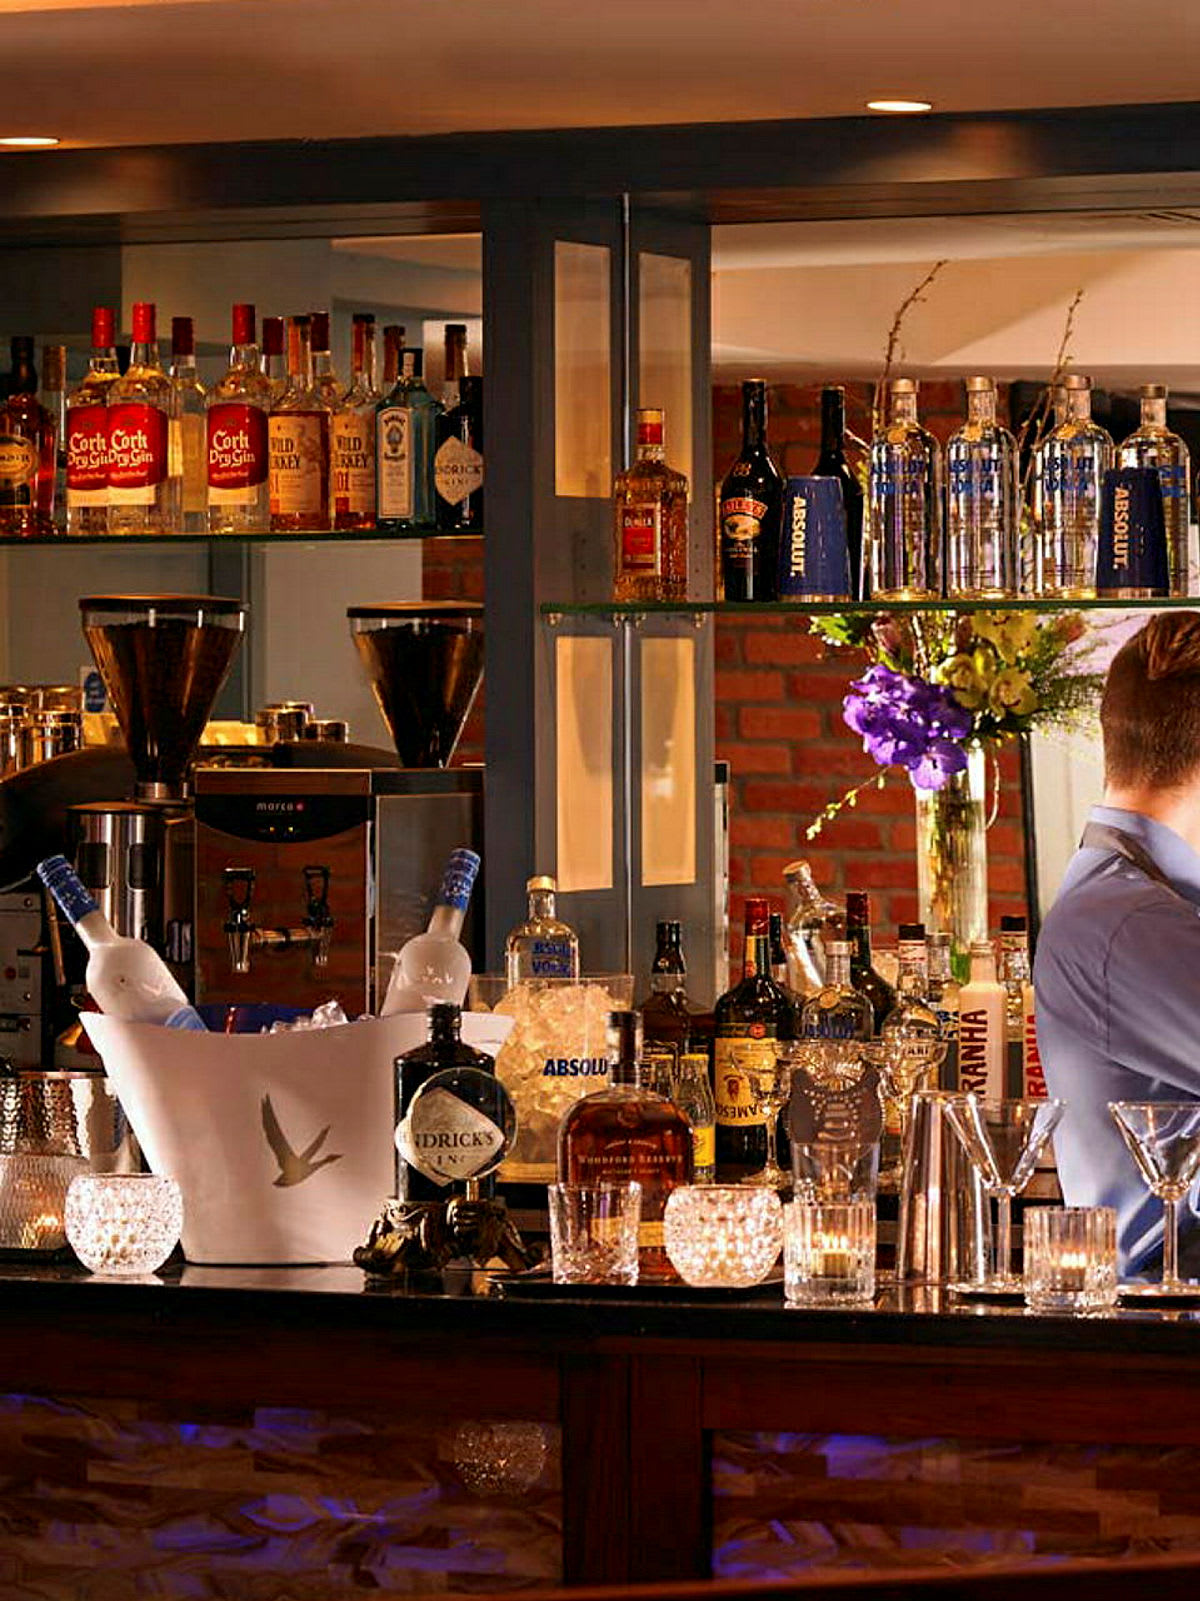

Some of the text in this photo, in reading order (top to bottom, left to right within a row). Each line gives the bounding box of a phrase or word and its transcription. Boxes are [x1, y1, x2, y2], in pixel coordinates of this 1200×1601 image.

[70, 432, 107, 453] Cork
[111, 429, 149, 451] Cork
[213, 430, 250, 451] Cork
[210, 450, 232, 468] Dry
[960, 1009, 988, 1095] RANHA
[543, 1058, 609, 1077] ABSOLU
[414, 1129, 494, 1149] NDRICK'S
